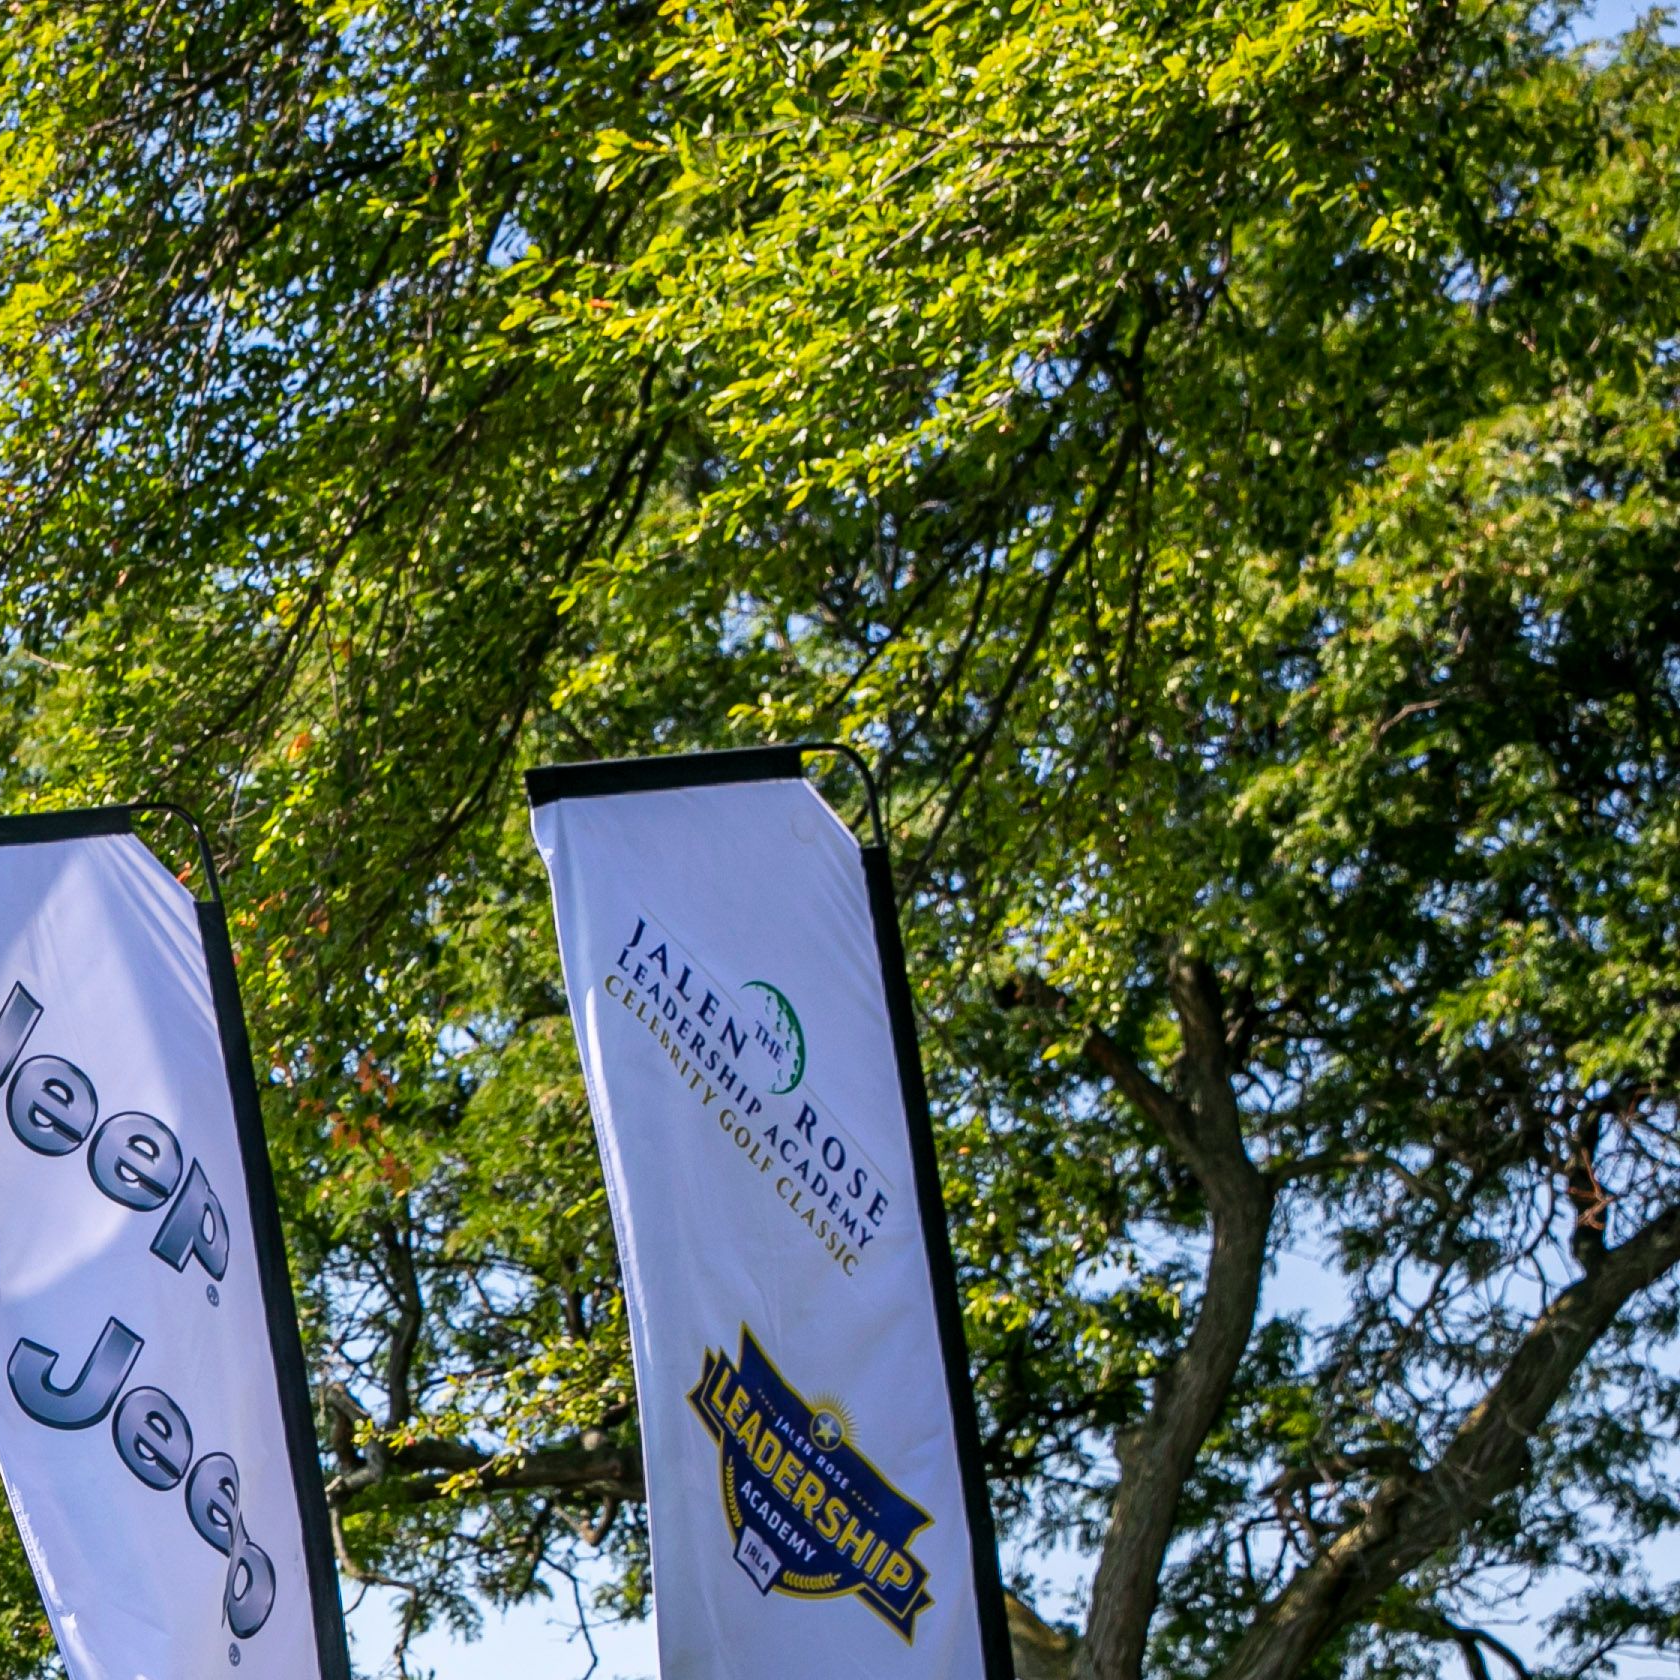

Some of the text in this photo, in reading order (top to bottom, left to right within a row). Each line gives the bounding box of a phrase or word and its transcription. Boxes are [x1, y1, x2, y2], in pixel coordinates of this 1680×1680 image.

[604, 974, 860, 1279] CELEBRITY GOLF CLASSIC
[617, 948, 874, 1252] LEADERSHIP ACADEMY
[631, 916, 889, 1230] JALEN THE ROSE
[710, 1366, 914, 1593] LEADERSHIP
[739, 1479, 818, 1565] ACADEMY
[742, 1539, 773, 1578] JRLA
[775, 1414, 851, 1491] JALEN ROSE
